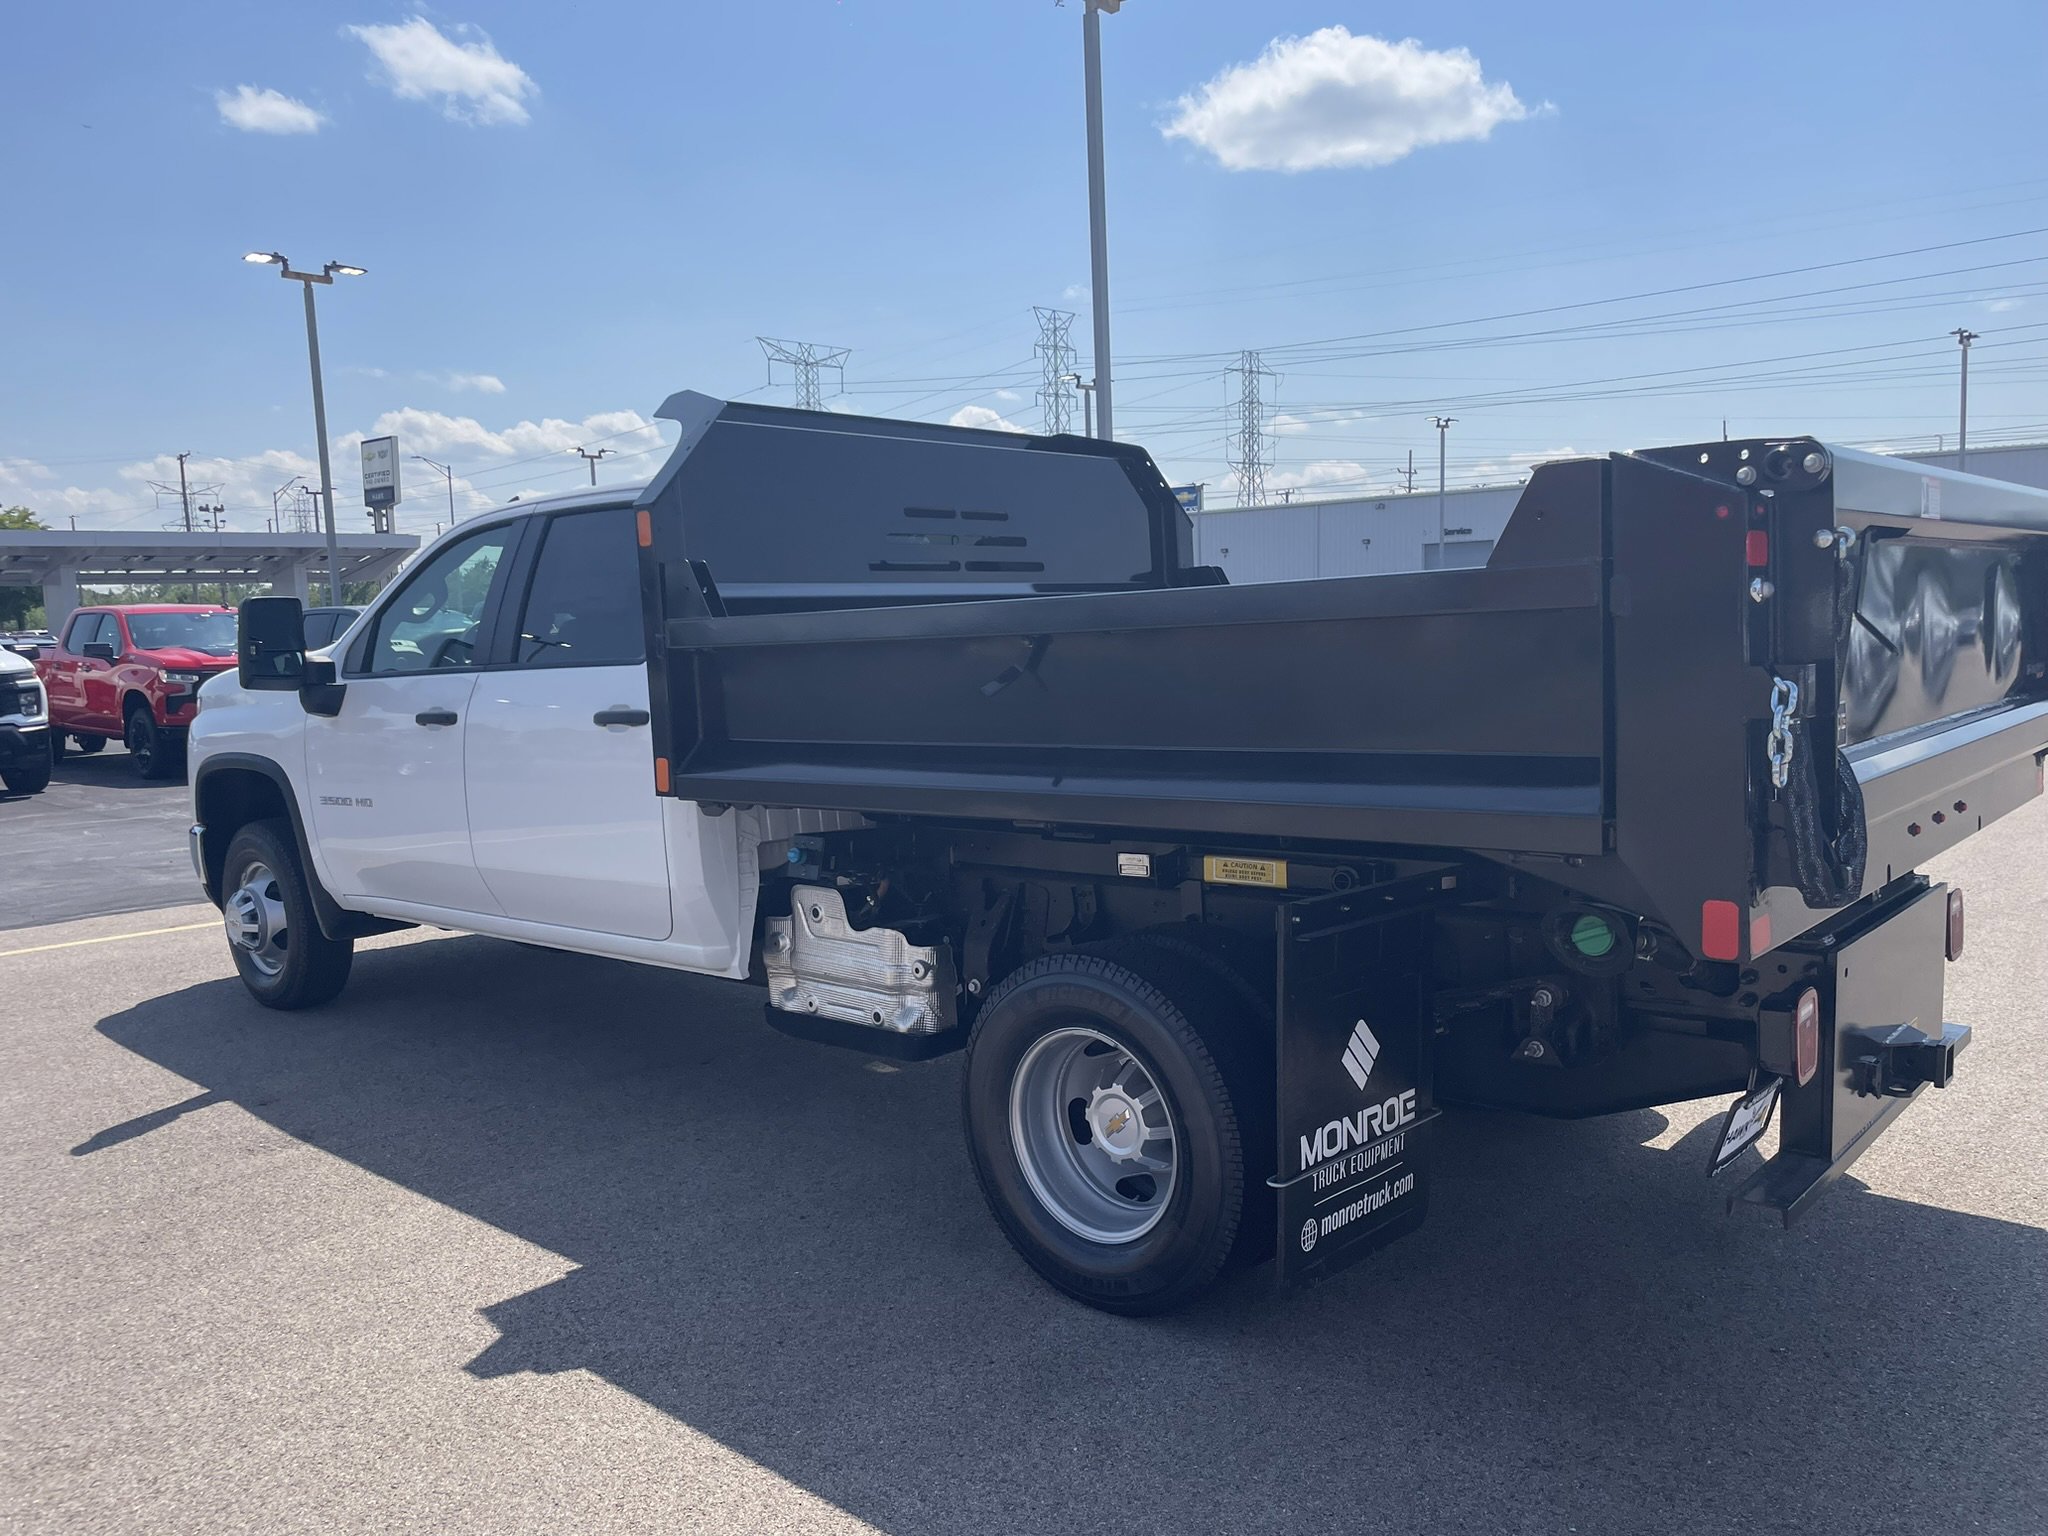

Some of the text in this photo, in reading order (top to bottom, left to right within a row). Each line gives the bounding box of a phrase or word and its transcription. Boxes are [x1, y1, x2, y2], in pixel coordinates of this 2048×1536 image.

[365, 470, 390, 479] CERTIFIED
[1444, 527, 1472, 536] Service
[320, 796, 373, 808] 3500 HD
[1230, 861, 1258, 870] CAUTION
[1300, 1088, 1416, 1171] MONROE
[1312, 1132, 1406, 1192] TRUCK EQUIPMENT
[1321, 1171, 1415, 1237] monroetruck.com
